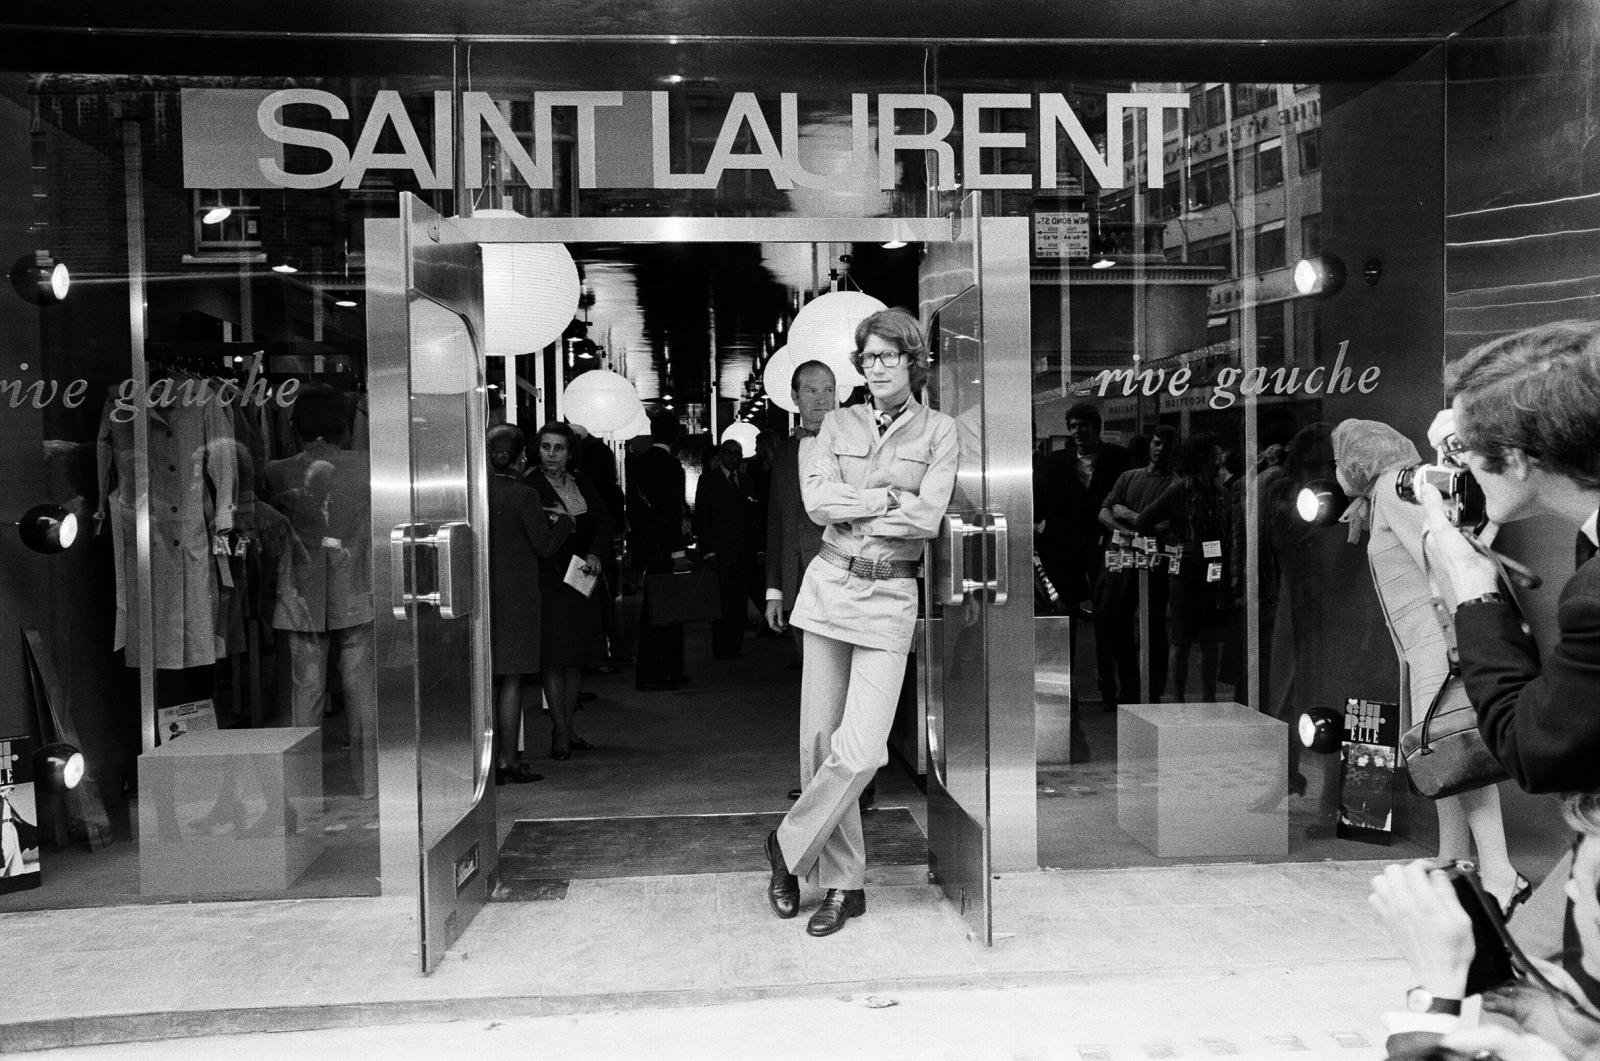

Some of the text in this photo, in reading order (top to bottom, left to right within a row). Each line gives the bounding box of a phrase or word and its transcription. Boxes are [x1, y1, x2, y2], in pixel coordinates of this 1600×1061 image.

[256, 88, 1190, 190] SAINT LAURENT
[0, 350, 300, 422] ive gauche
[1096, 340, 1382, 410] rive gauche
[1350, 727, 1379, 744] ELLE
